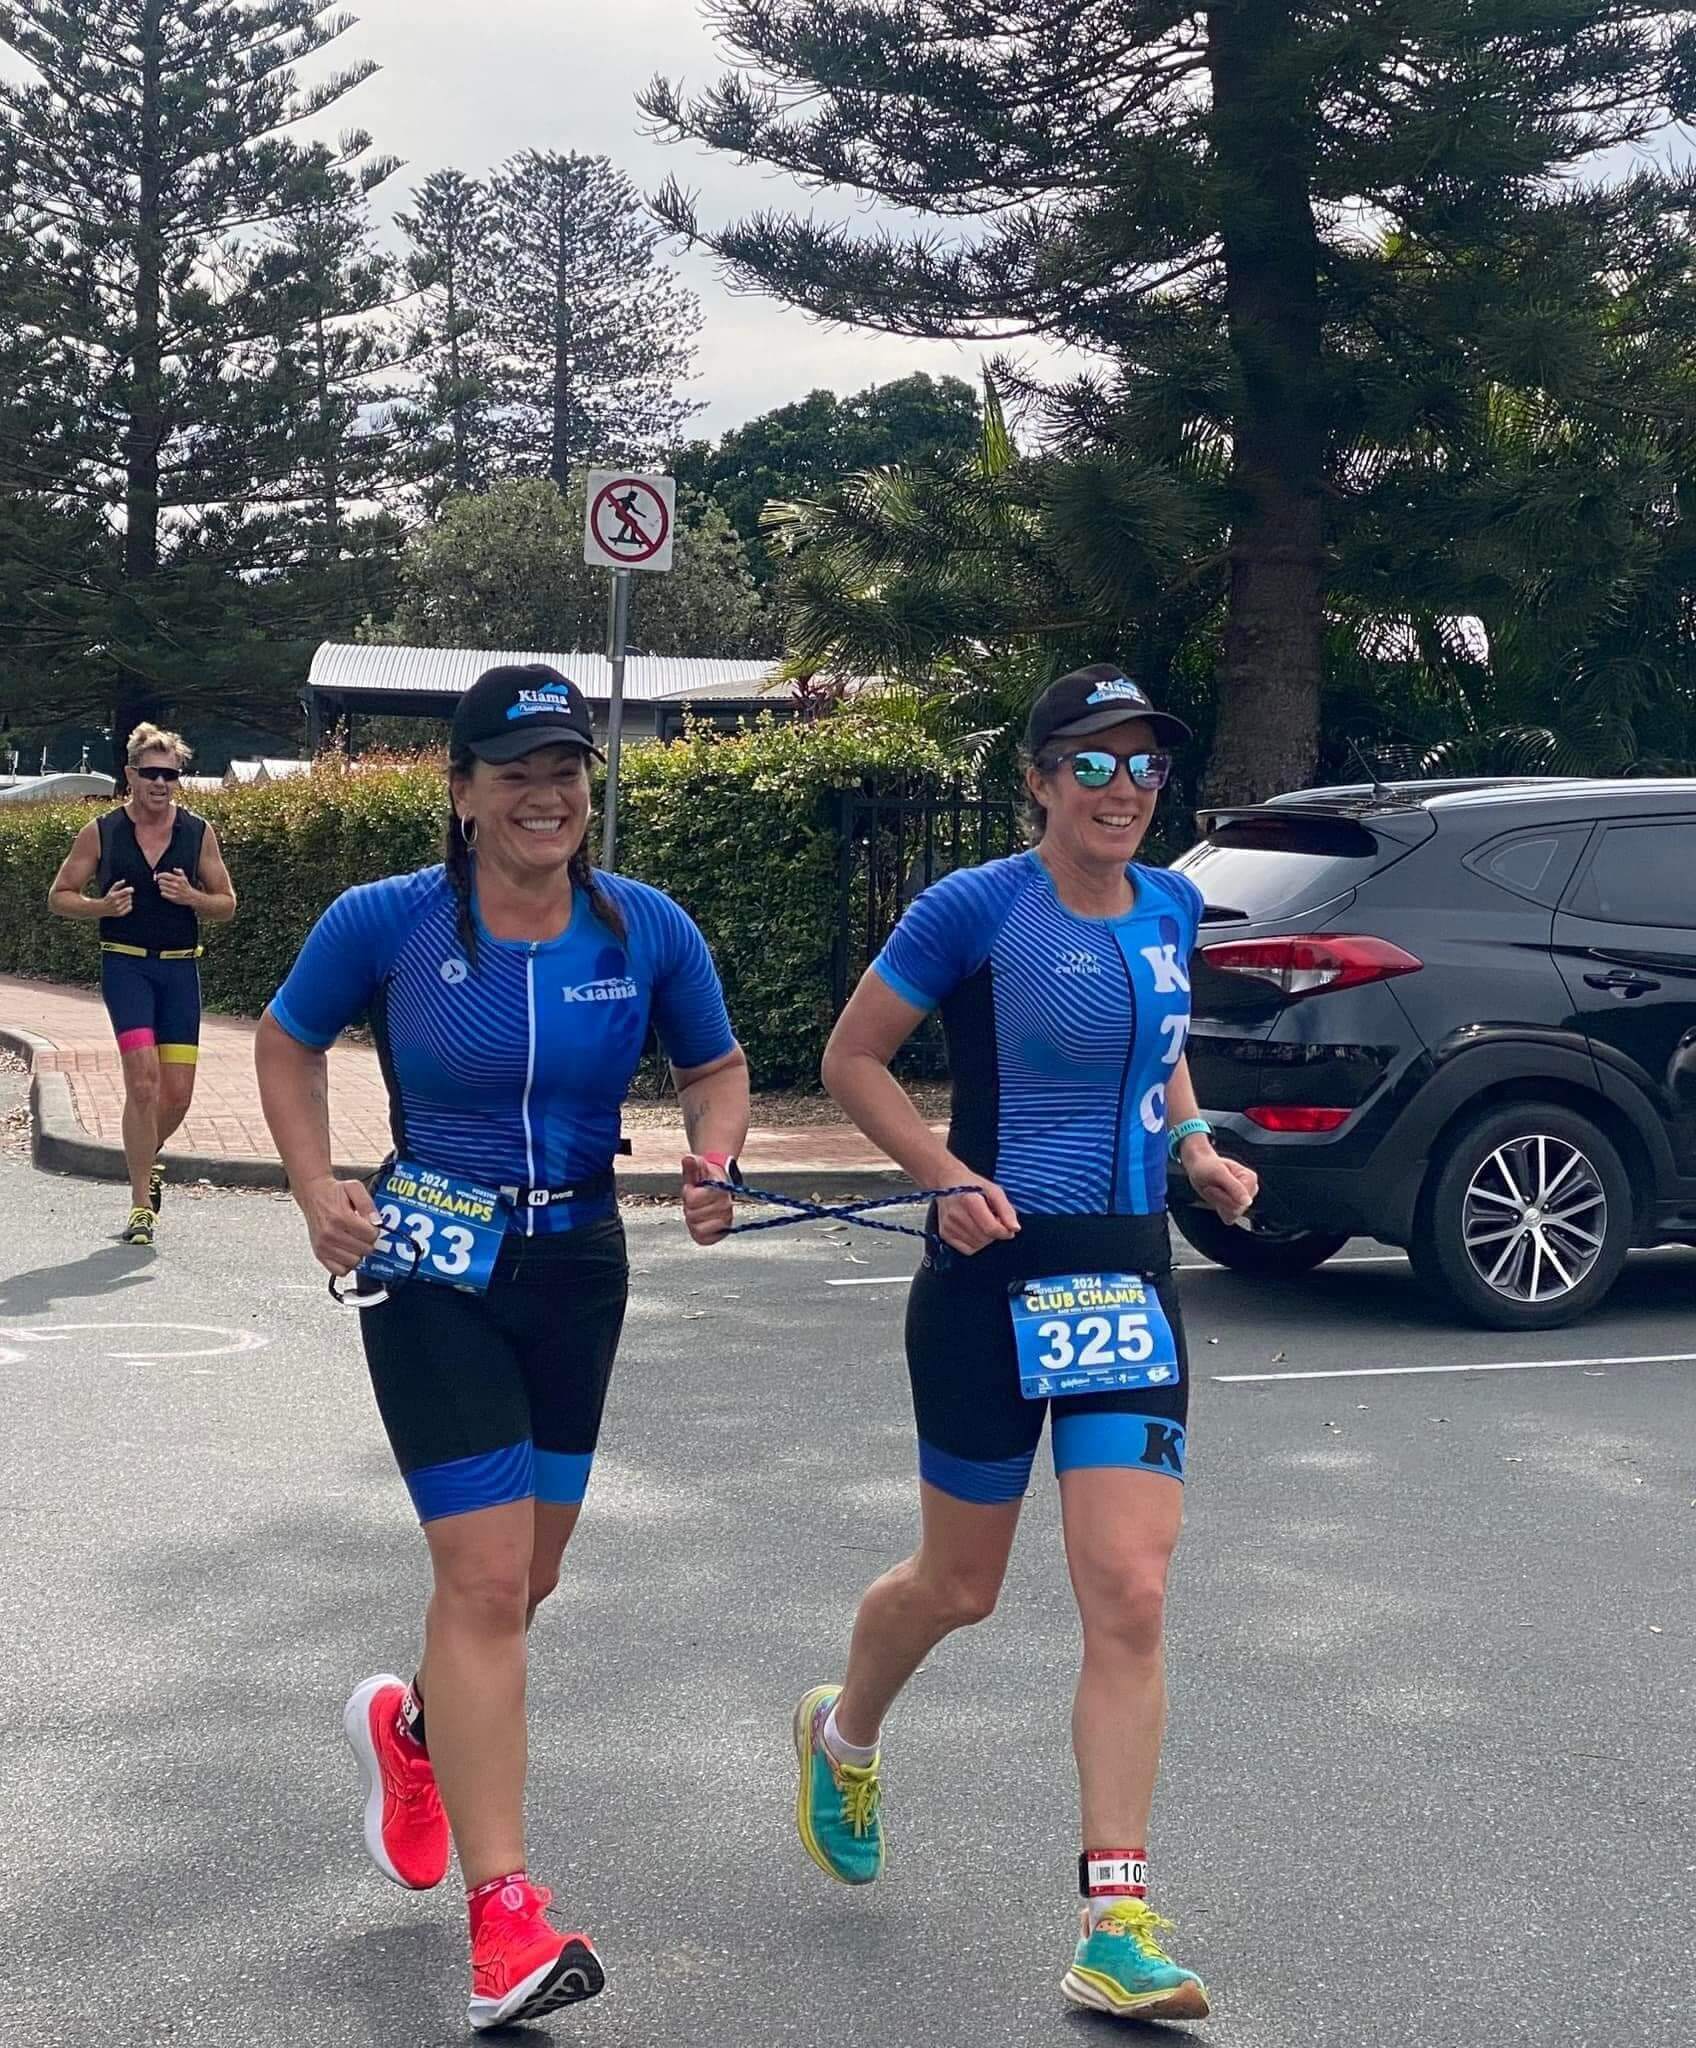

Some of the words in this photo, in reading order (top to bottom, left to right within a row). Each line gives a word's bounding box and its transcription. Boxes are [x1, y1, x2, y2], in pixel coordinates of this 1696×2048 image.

[518, 690, 568, 705] Kiama
[562, 981, 638, 1003] Kiama
[420, 1171, 449, 1190] 2024
[386, 1177, 417, 1197] CLUB
[417, 1186, 494, 1222] CHAMPS
[1071, 1277, 1102, 1290] 2024
[1026, 1292, 1075, 1312] CLUB
[1077, 1286, 1147, 1306] CHAMPS
[1038, 1313, 1153, 1369] 325
